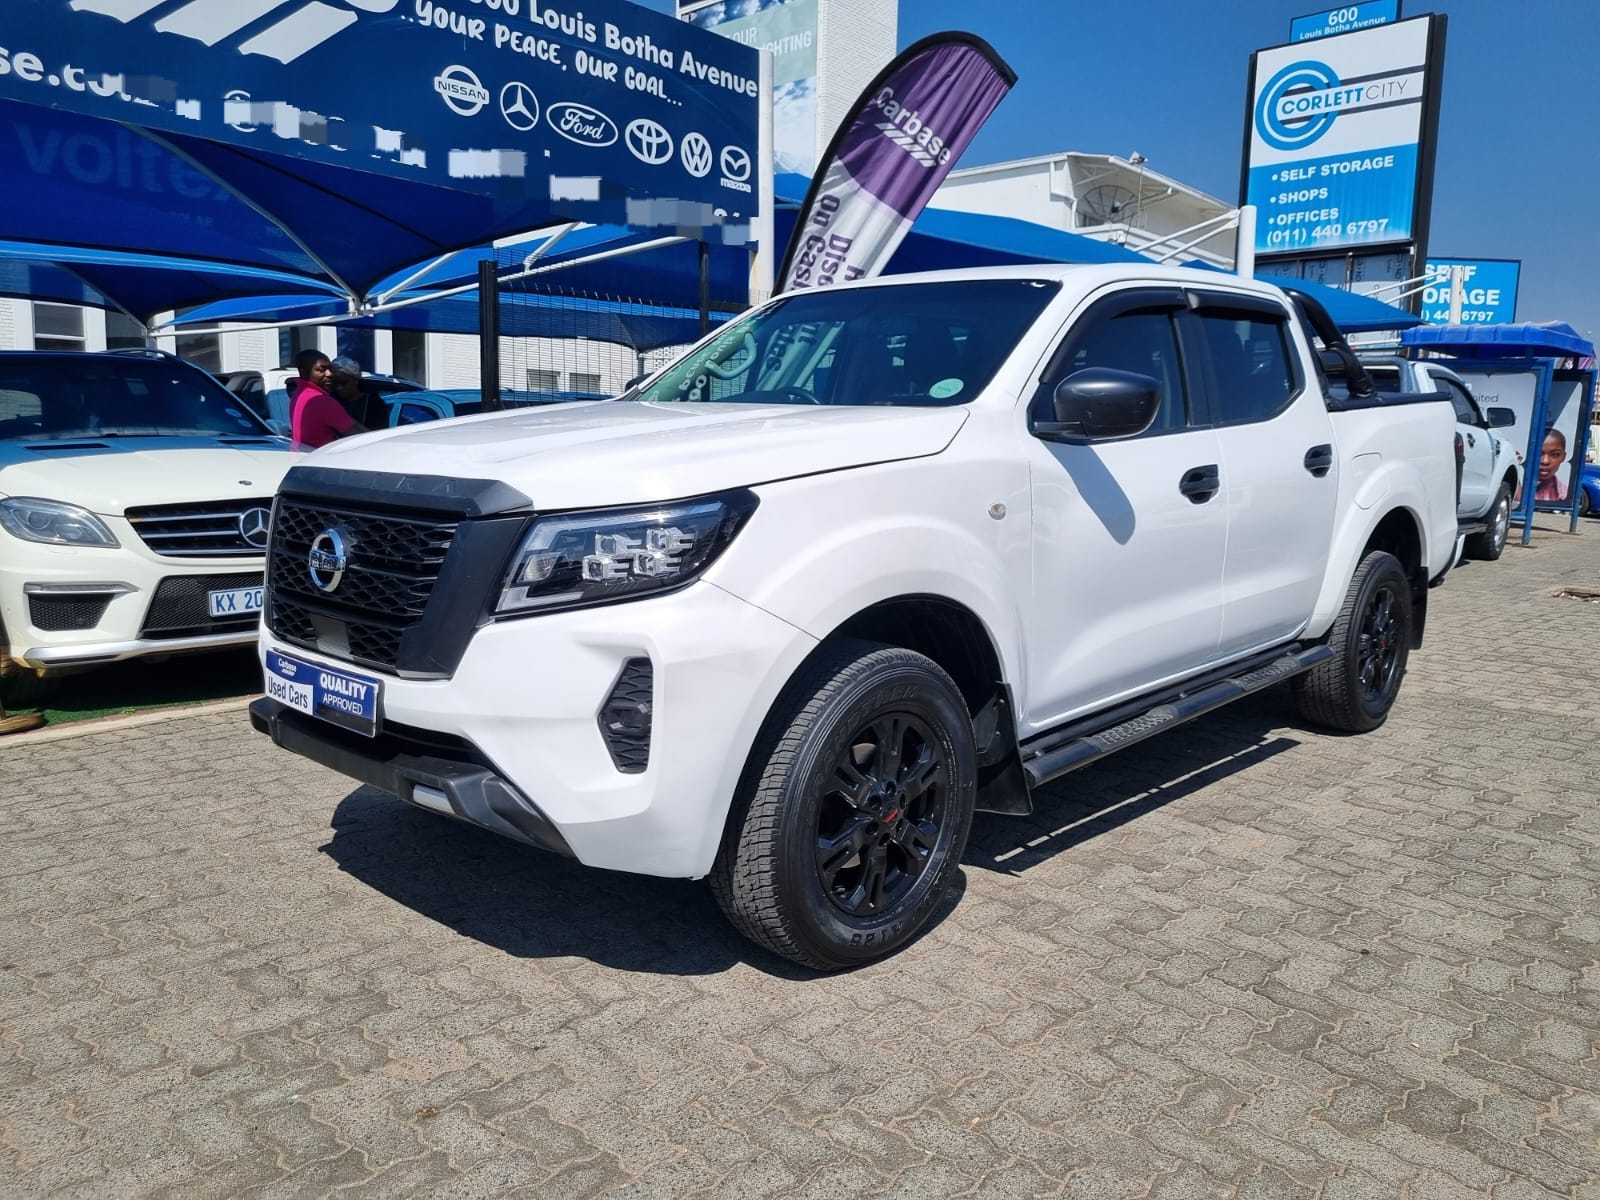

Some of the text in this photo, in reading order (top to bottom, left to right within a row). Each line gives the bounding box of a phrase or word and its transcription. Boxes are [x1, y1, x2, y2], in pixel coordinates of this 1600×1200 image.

[1299, 16, 1386, 40] Louis Botha Avenue
[1328, 7, 1359, 26] 600
[530, 0, 759, 98] Louis Botha Avenue
[762, 31, 812, 56] GHTING
[575, 50, 618, 82] OUR
[438, 80, 487, 101] NISSAN
[560, 108, 606, 140] Ford
[876, 86, 952, 166] Carbase
[11, 119, 232, 202] volte
[1280, 155, 1395, 182] SELF STORAGE
[1278, 187, 1328, 204] SHOPS
[812, 194, 841, 228] On
[1276, 207, 1339, 226] OFFICES
[1266, 218, 1389, 247] (011) 440 6797
[1425, 264, 1477, 281] SEF
[1422, 287, 1500, 305] ORAGE
[1461, 311, 1494, 321] 6797
[215, 593, 236, 613] KX
[268, 675, 309, 709] Used Cars
[320, 673, 368, 700] QUALITY
[322, 693, 363, 715] APPROVED
